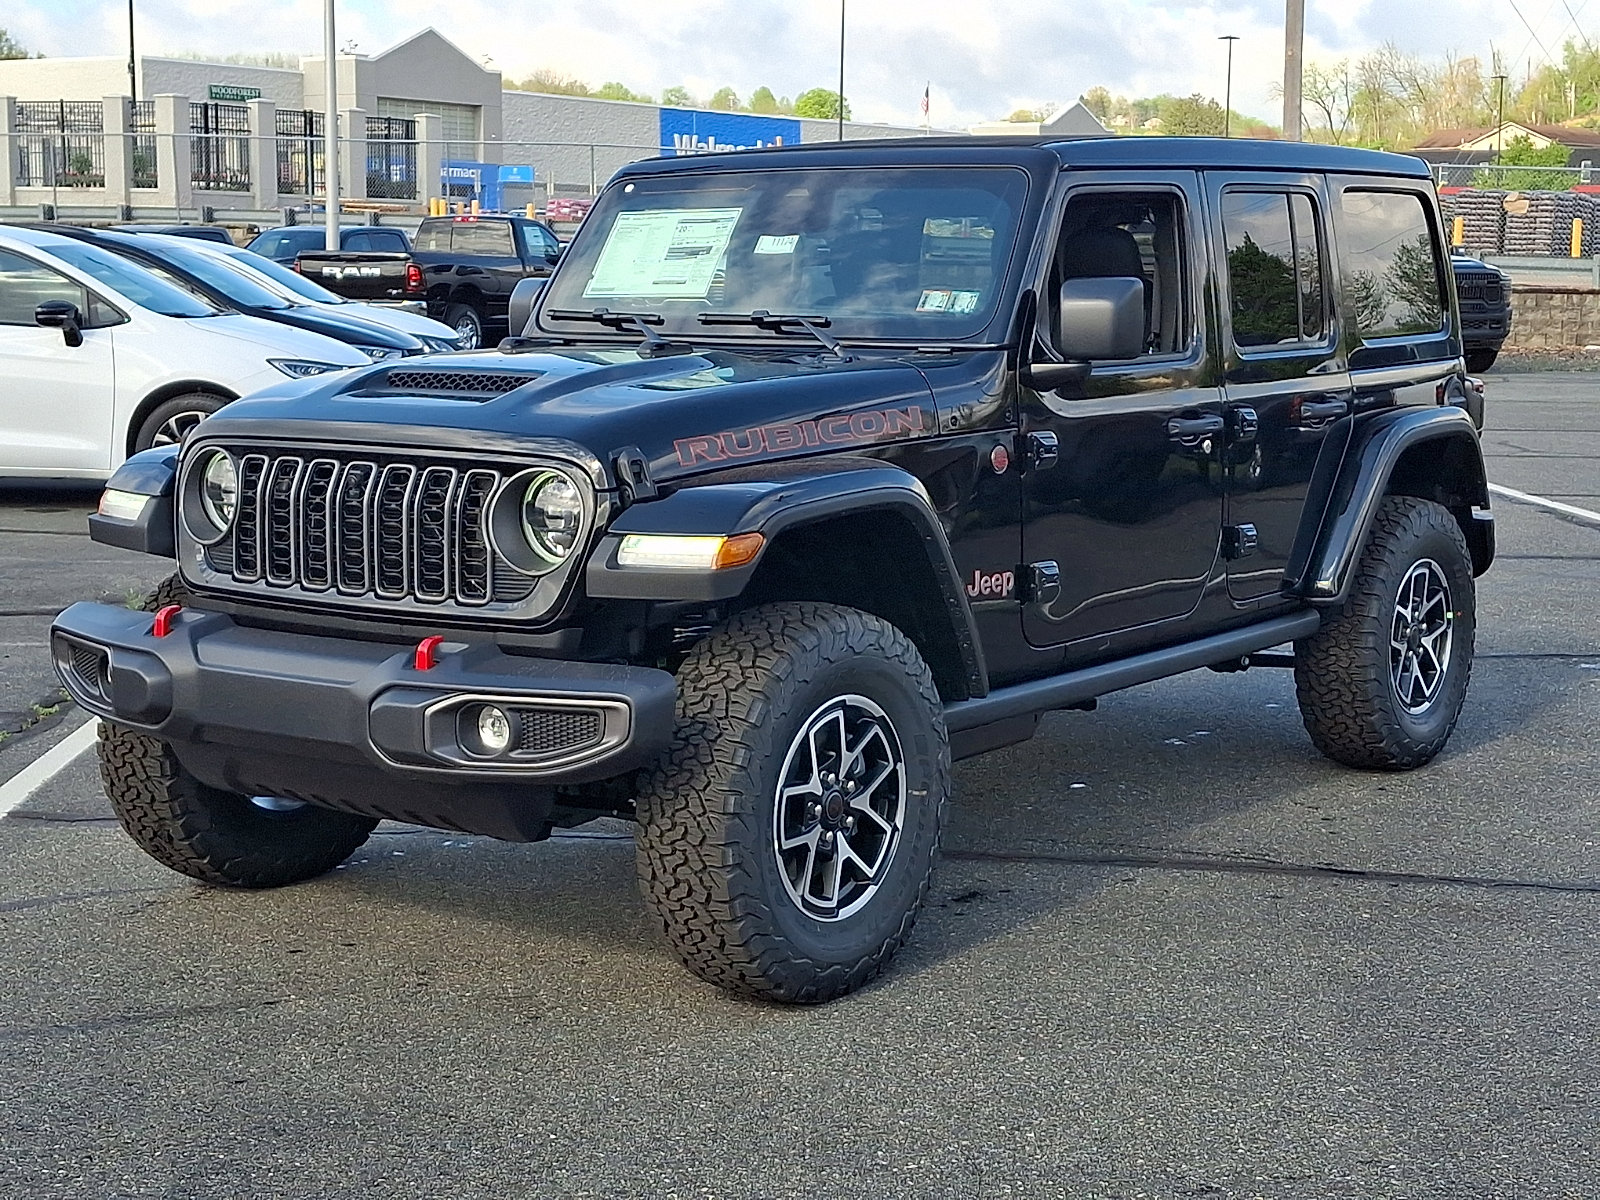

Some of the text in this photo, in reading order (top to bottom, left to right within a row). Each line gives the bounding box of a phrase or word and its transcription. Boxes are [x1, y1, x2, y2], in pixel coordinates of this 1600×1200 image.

[211, 86, 260, 97] WOODFOREST
[321, 266, 381, 279] RAM
[673, 405, 924, 467] RUBICON
[966, 568, 1015, 598] Jeep
